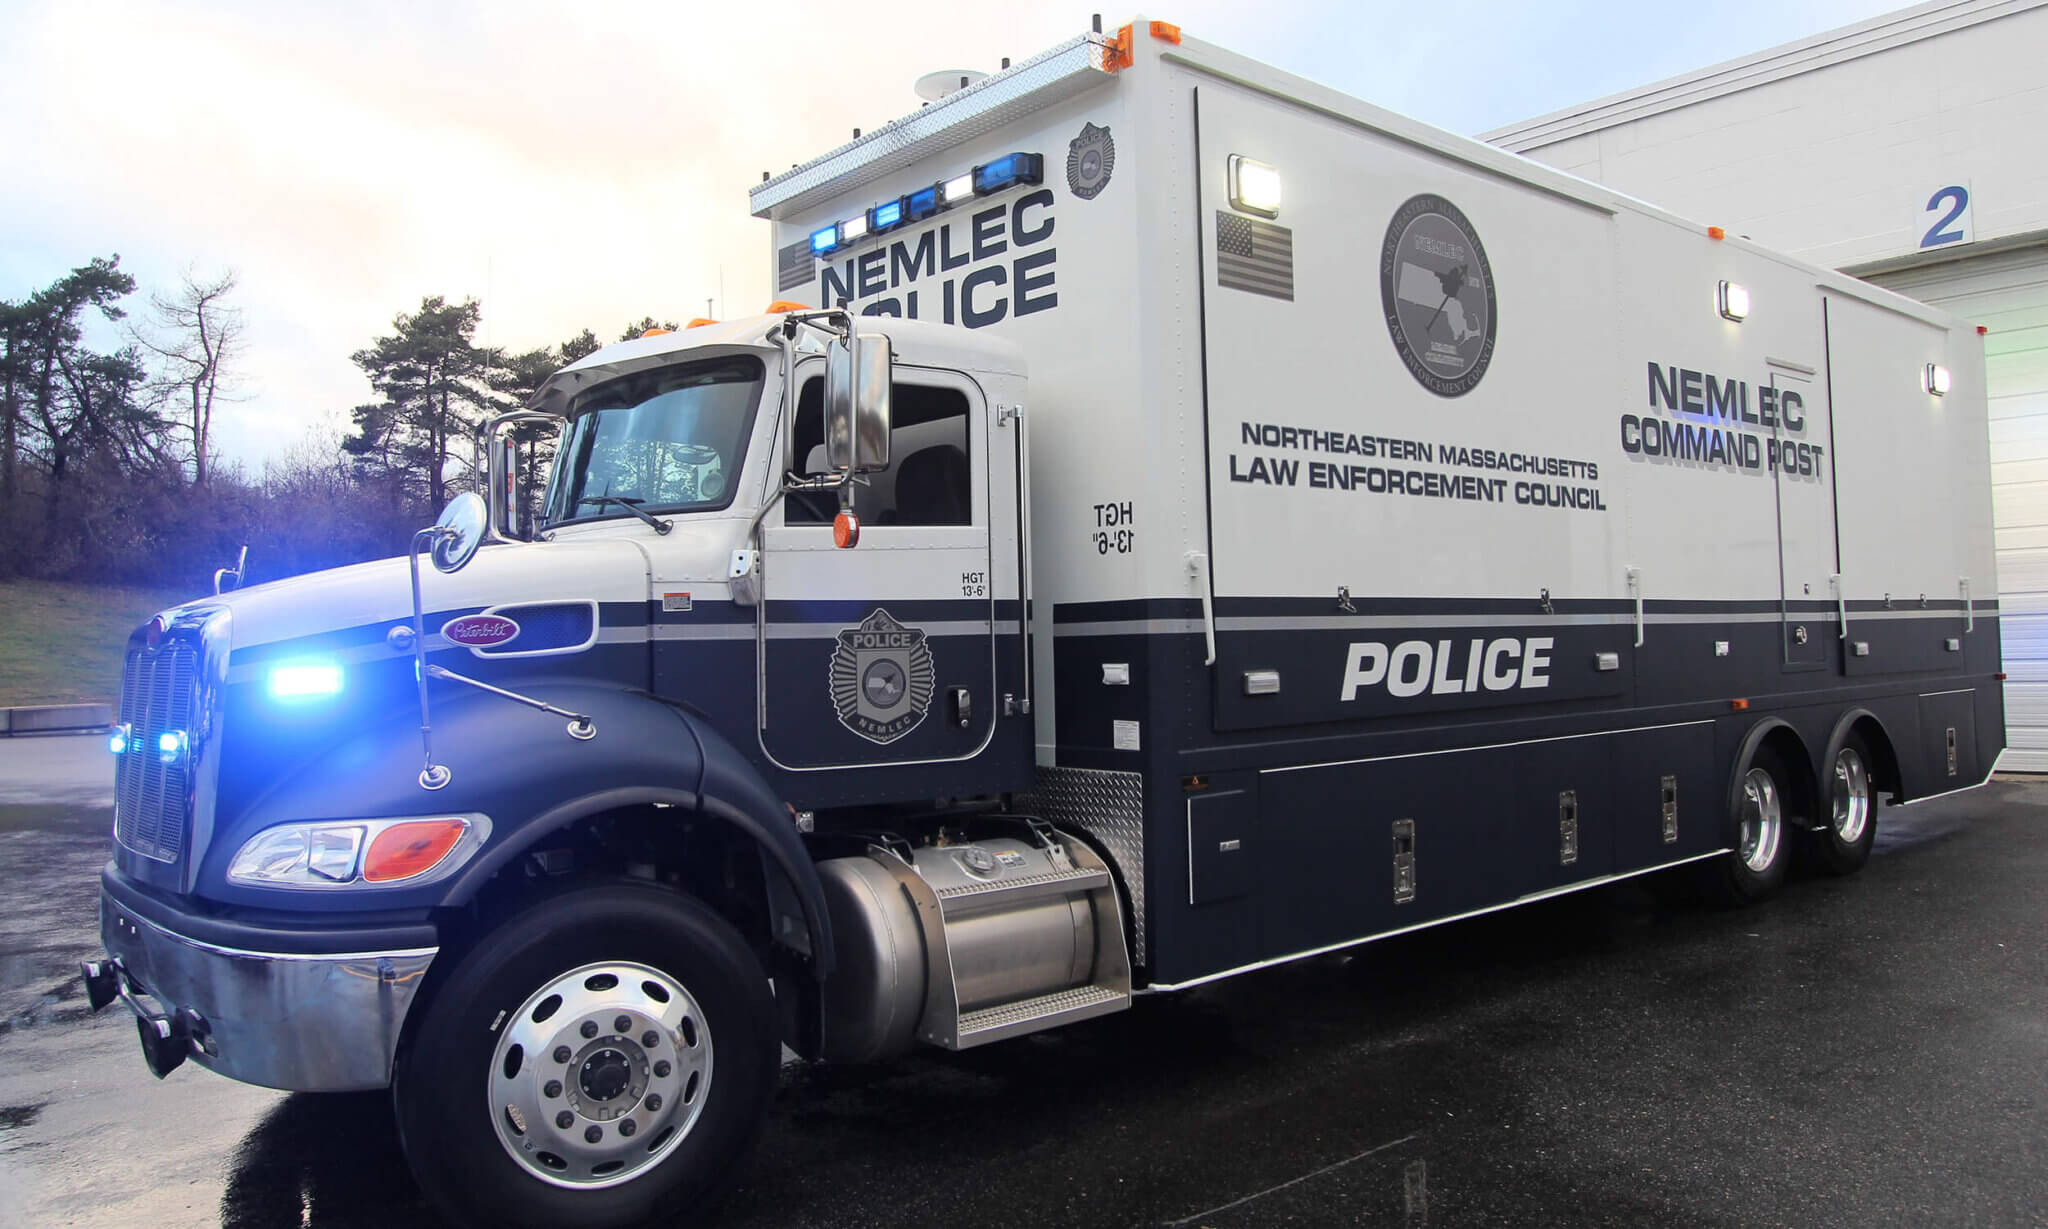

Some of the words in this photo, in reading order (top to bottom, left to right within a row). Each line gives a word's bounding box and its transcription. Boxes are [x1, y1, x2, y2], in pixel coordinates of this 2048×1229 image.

[1920, 186, 1968, 248] 2
[821, 189, 1055, 311] NEMLEC
[861, 247, 1058, 329] ICE
[1648, 361, 1804, 431] NEMLEC
[1241, 422, 1433, 463] NORTHEASTERN
[1439, 445, 1599, 480] MASSACHUSETTS
[1621, 414, 1760, 469] COMMAND
[1767, 438, 1824, 478] POST
[1230, 455, 1300, 486] LAW
[1309, 462, 1507, 503] ENFORCEMENT
[1514, 482, 1607, 511] COUNCIL
[962, 572, 985, 584] HGT
[454, 622, 512, 640] Peterbilt
[853, 633, 912, 648] POLICE
[1340, 637, 1554, 701] POLICE
[858, 716, 911, 733] NEMLEC
